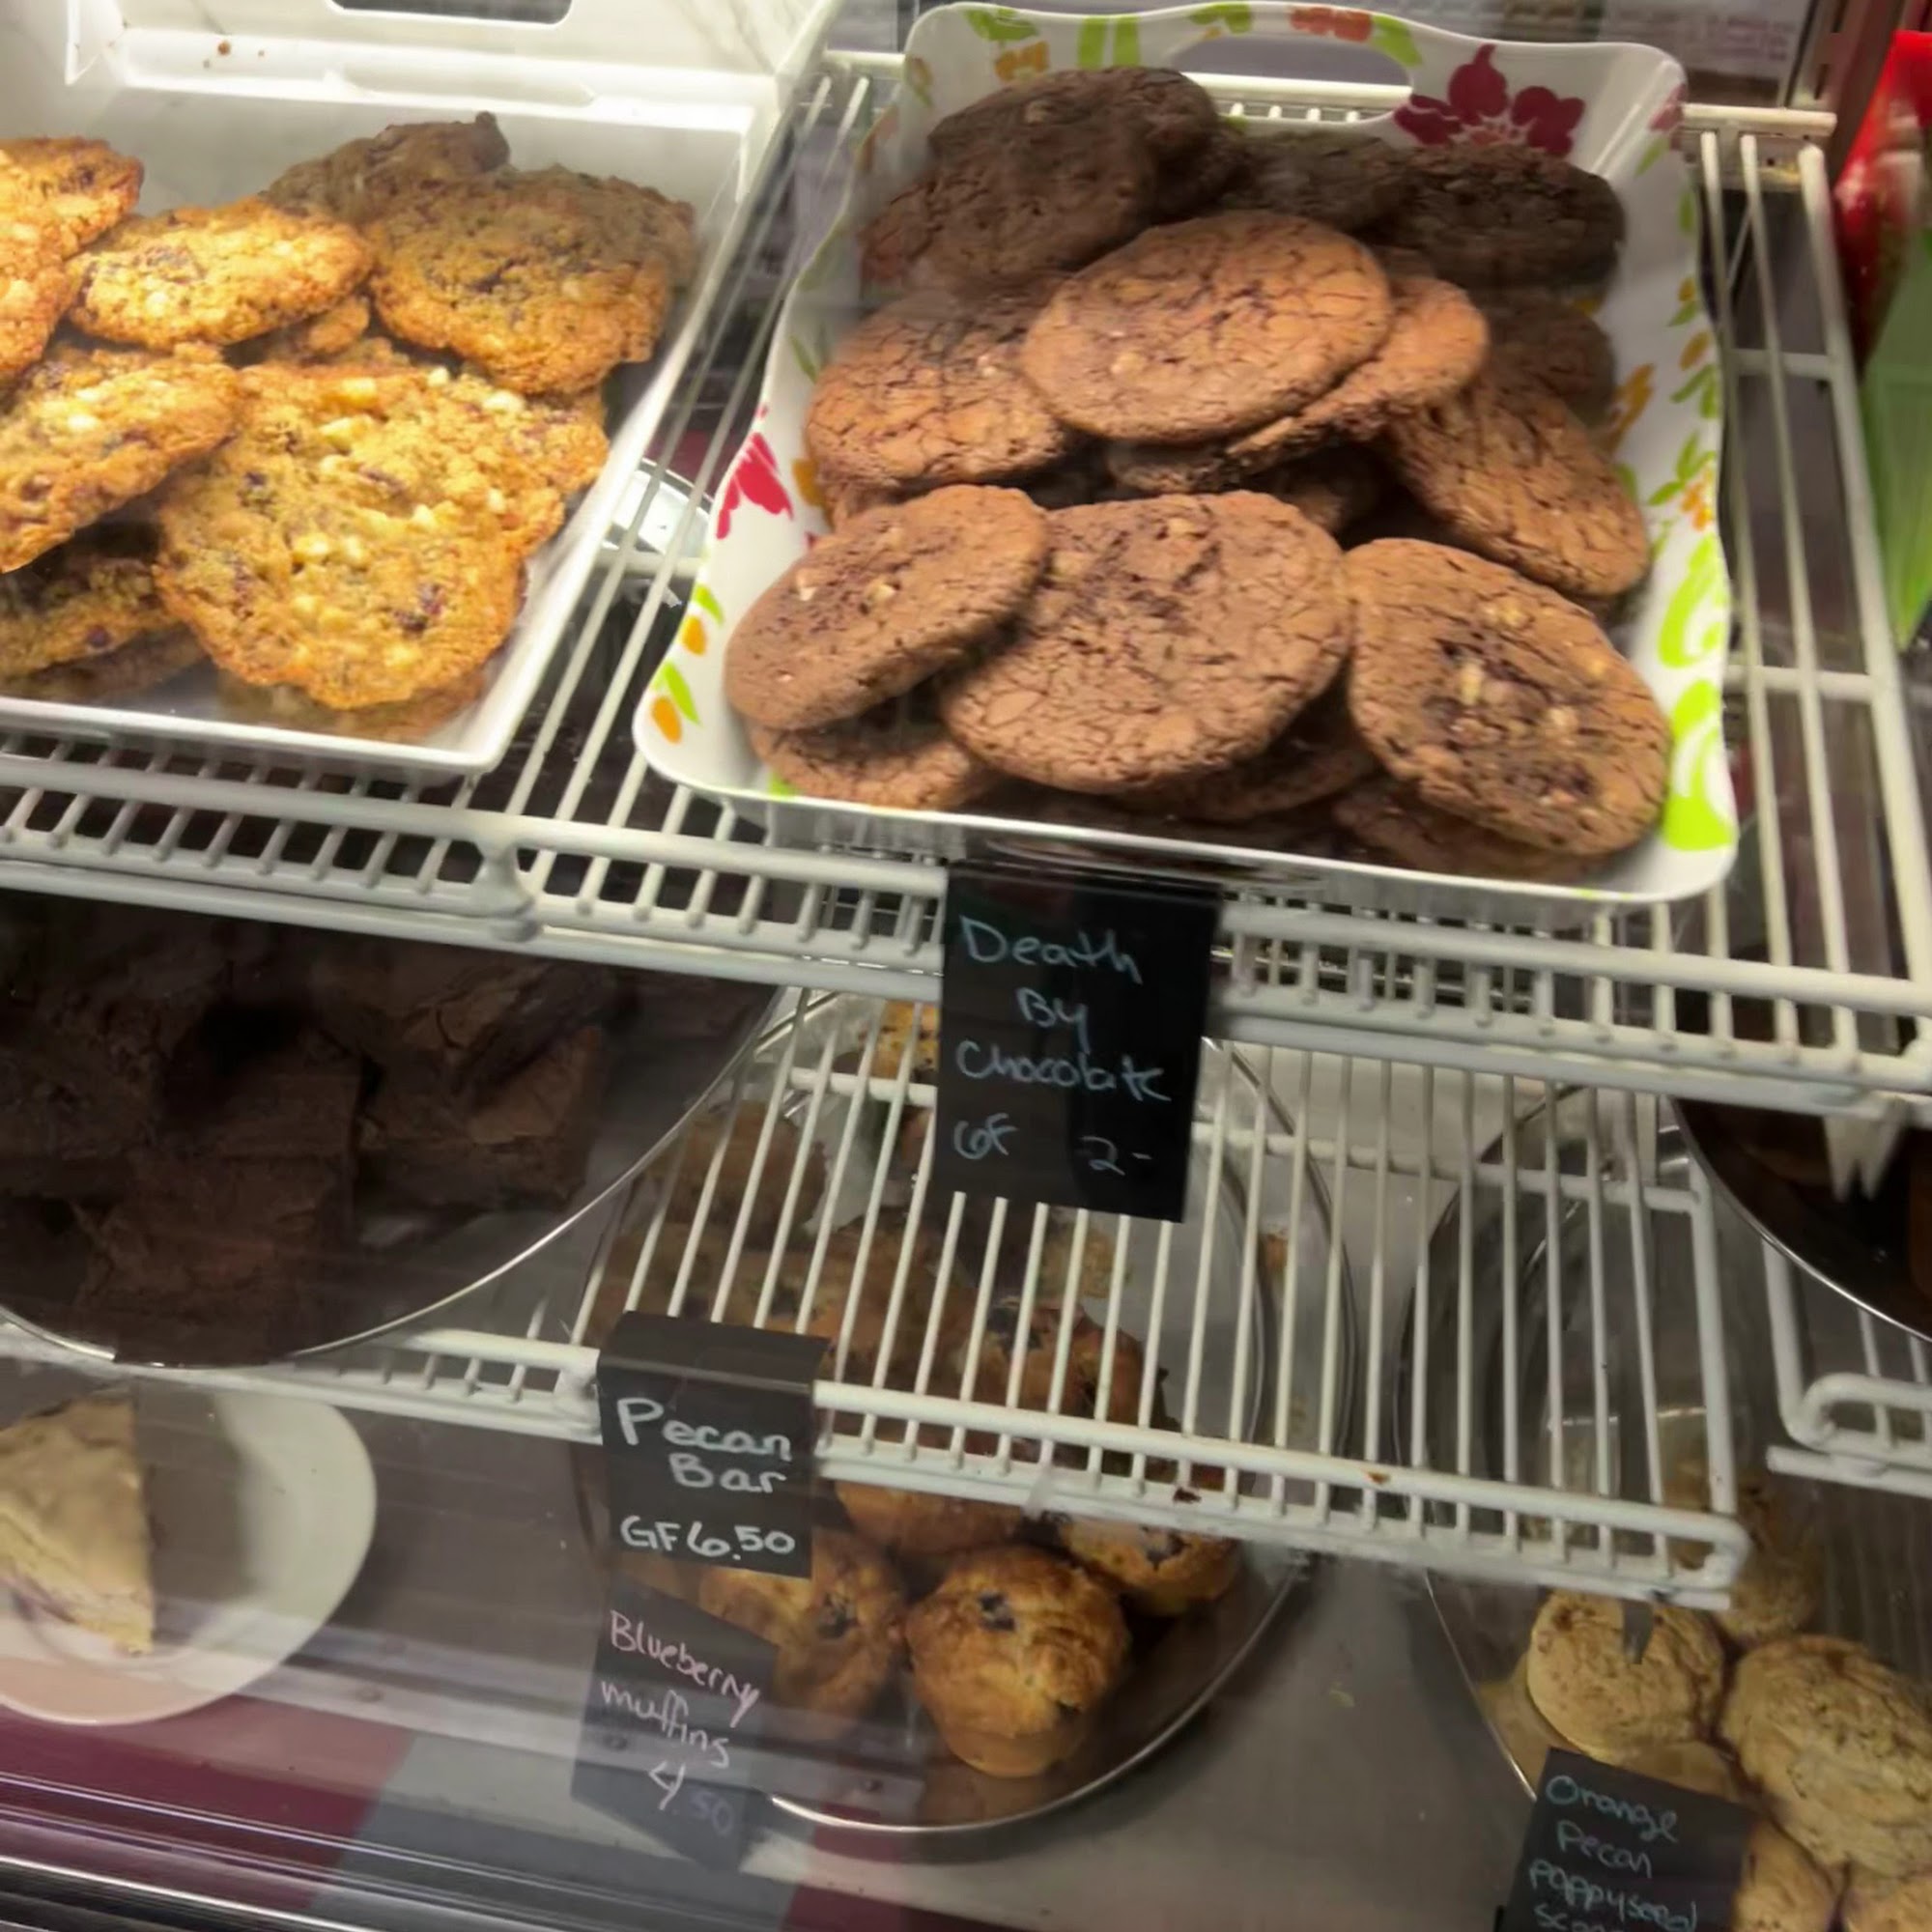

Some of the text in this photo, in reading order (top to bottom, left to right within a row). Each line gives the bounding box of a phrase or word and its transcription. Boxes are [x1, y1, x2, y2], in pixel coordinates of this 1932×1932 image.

[959, 915, 1144, 986] Death
[1016, 987, 1092, 1055] By
[956, 1039, 1172, 1101] Chocolate
[953, 1112, 1019, 1160] GF
[616, 1396, 793, 1463] Pecan
[668, 1452, 787, 1493] Bar
[610, 1608, 760, 1729] Blueberry
[600, 1680, 729, 1769] muffins
[1546, 1774, 1679, 1844] Orange
